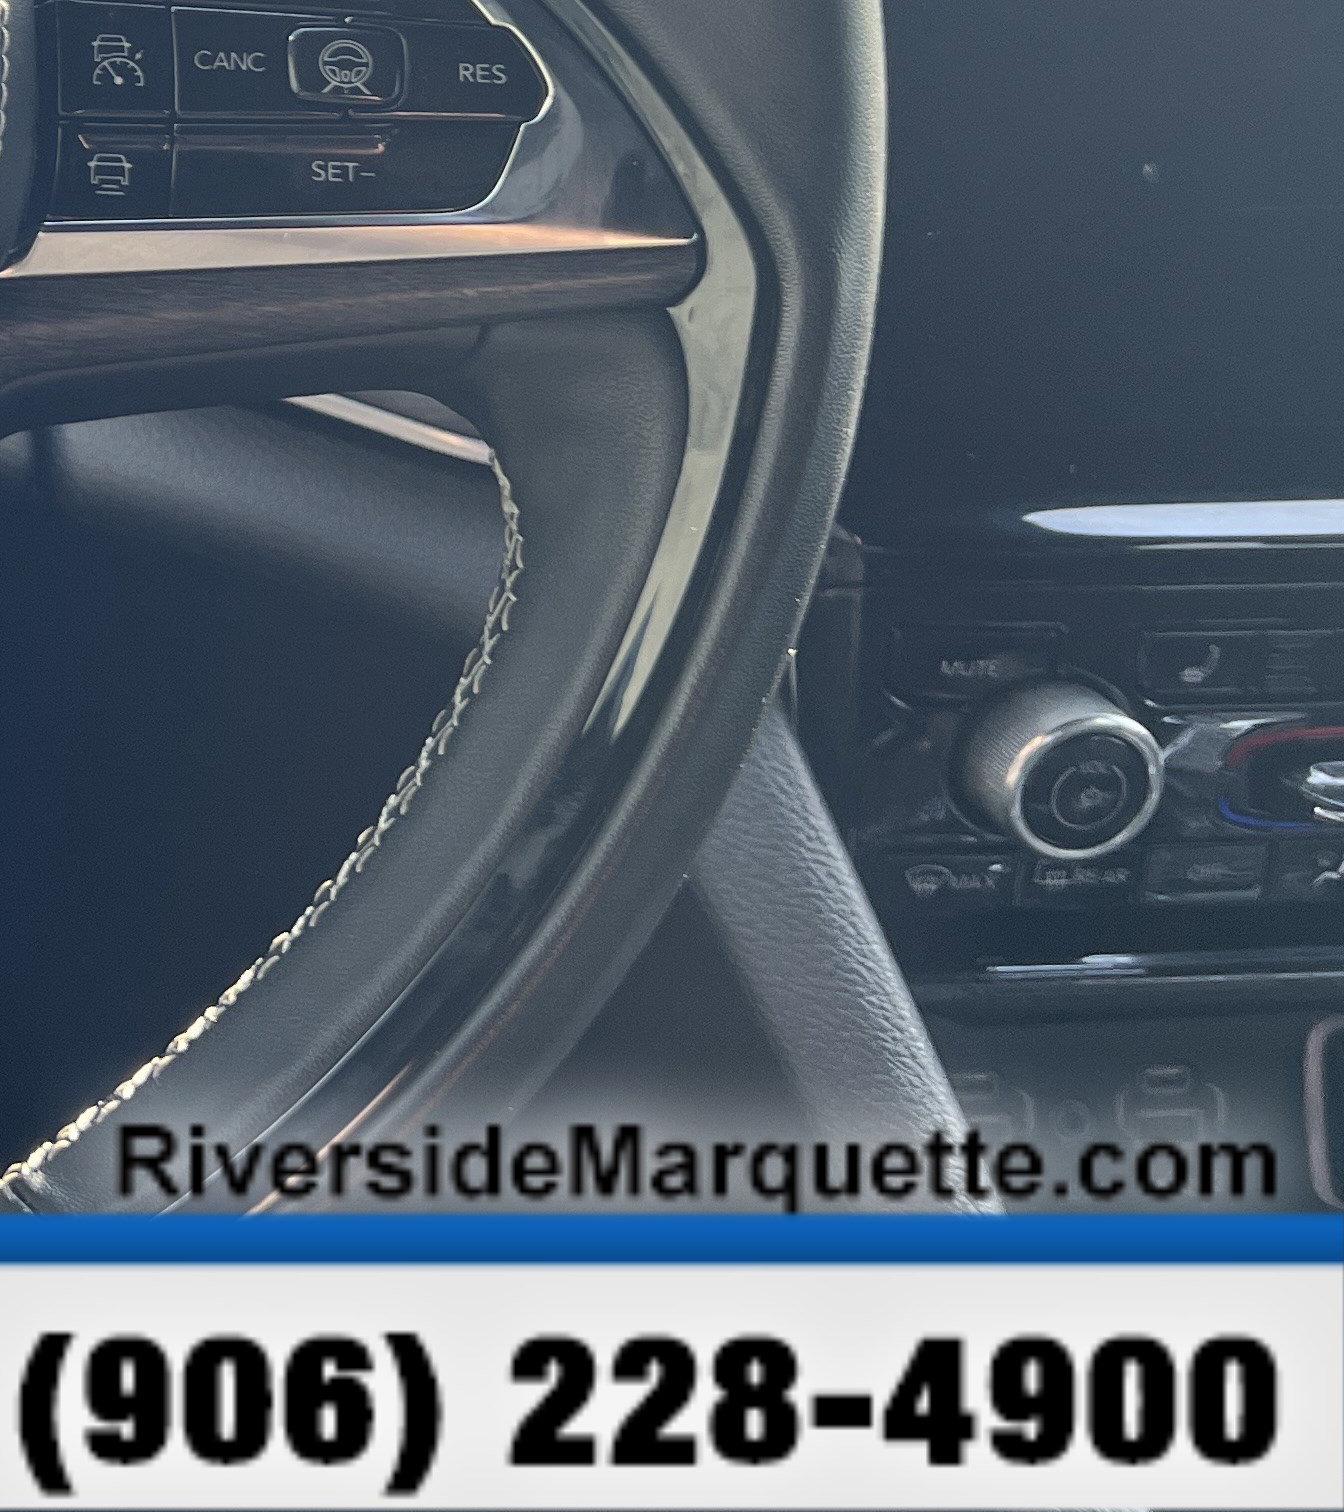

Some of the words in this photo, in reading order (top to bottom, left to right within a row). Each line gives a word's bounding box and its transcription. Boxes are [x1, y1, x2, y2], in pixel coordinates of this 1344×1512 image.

[193, 50, 267, 72] CANC
[459, 63, 508, 85] RES
[939, 660, 1000, 677] MUTE
